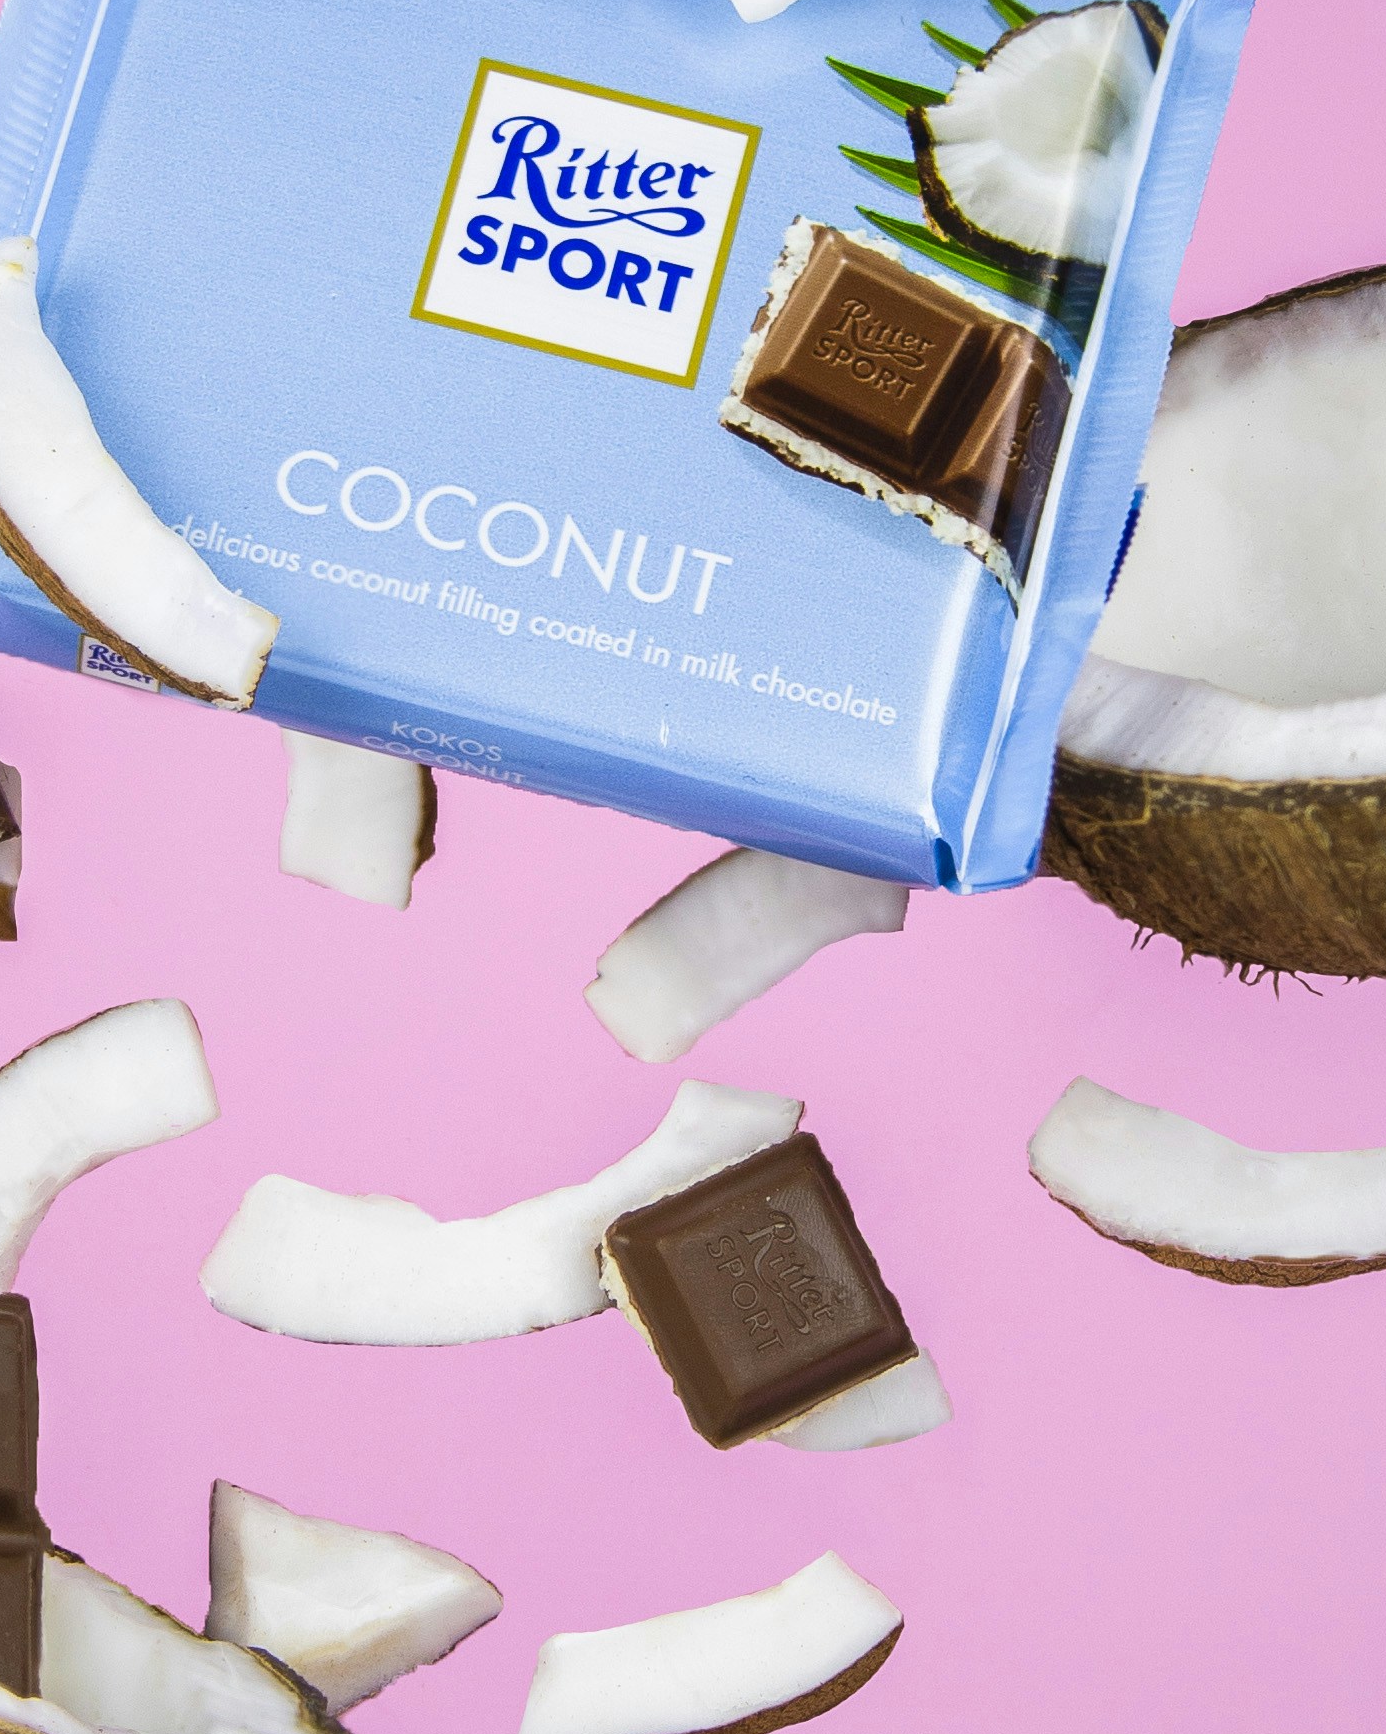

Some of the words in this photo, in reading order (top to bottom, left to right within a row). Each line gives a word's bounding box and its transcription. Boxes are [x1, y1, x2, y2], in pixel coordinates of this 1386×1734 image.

[476, 115, 716, 237] Ritter
[457, 214, 695, 313] SPORT
[813, 337, 917, 401] SPORT
[828, 297, 936, 371] Ritter
[276, 449, 734, 615] COCONUT
[171, 513, 301, 572] delicious
[310, 559, 431, 606] coconut
[438, 579, 520, 636] filling
[528, 614, 637, 659] coated
[642, 636, 671, 668] in
[679, 651, 741, 687] milk
[749, 665, 897, 726] chocolate
[87, 661, 154, 683] SPORT
[363, 735, 526, 785] COCONUT
[390, 720, 502, 762] KOKOS
[705, 1235, 785, 1353] SPORT
[739, 1210, 835, 1335] Ritter
